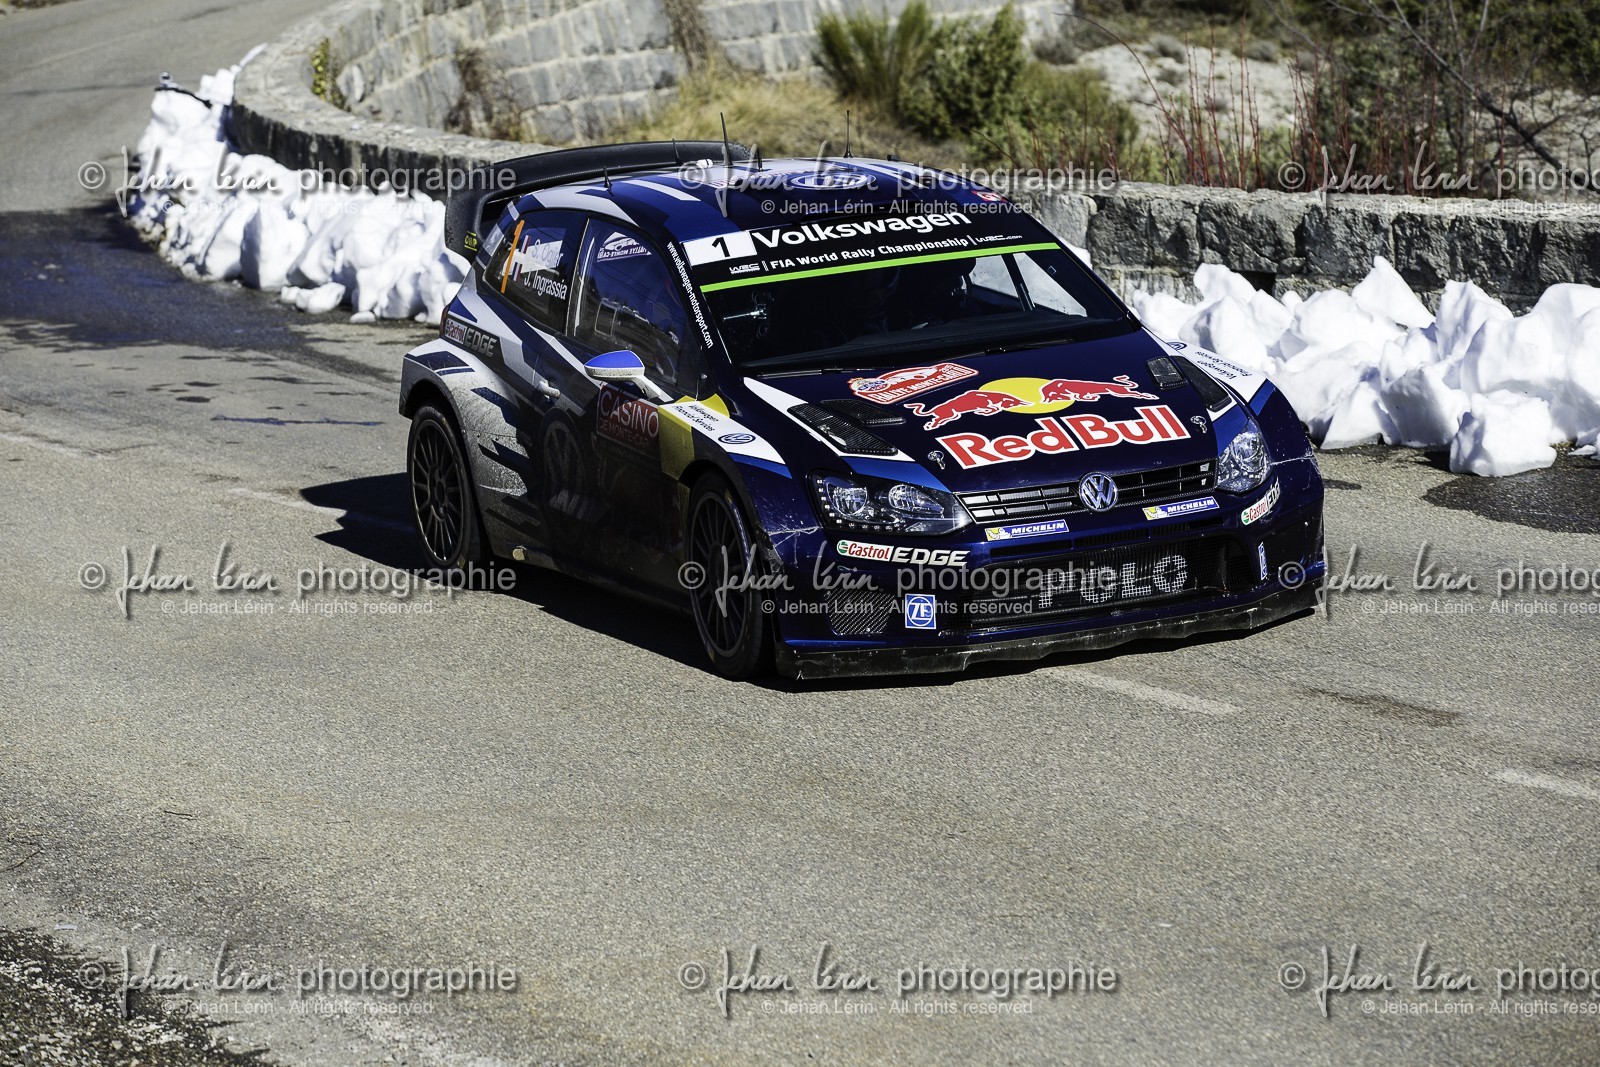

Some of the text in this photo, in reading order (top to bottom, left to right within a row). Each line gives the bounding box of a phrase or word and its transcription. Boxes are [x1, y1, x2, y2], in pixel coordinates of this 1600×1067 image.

[711, 209, 972, 258] 1 Volkswagen
[769, 259, 796, 270] FIA
[798, 253, 839, 266] World
[840, 247, 875, 260] Rally
[877, 236, 970, 256] Championship
[532, 269, 568, 301] Ingrassia
[666, 241, 714, 349] www.volkswagen-motorsport.com
[464, 327, 498, 358] EDGE
[600, 390, 659, 438] CASINO
[936, 404, 1192, 469] Red Bull
[1167, 498, 1216, 513] MICHELIN
[1249, 502, 1269, 521] Castrol
[1011, 521, 1066, 535] MICHELIN
[847, 542, 971, 567] Castrol EDGE
[1038, 554, 1189, 609] POLO
